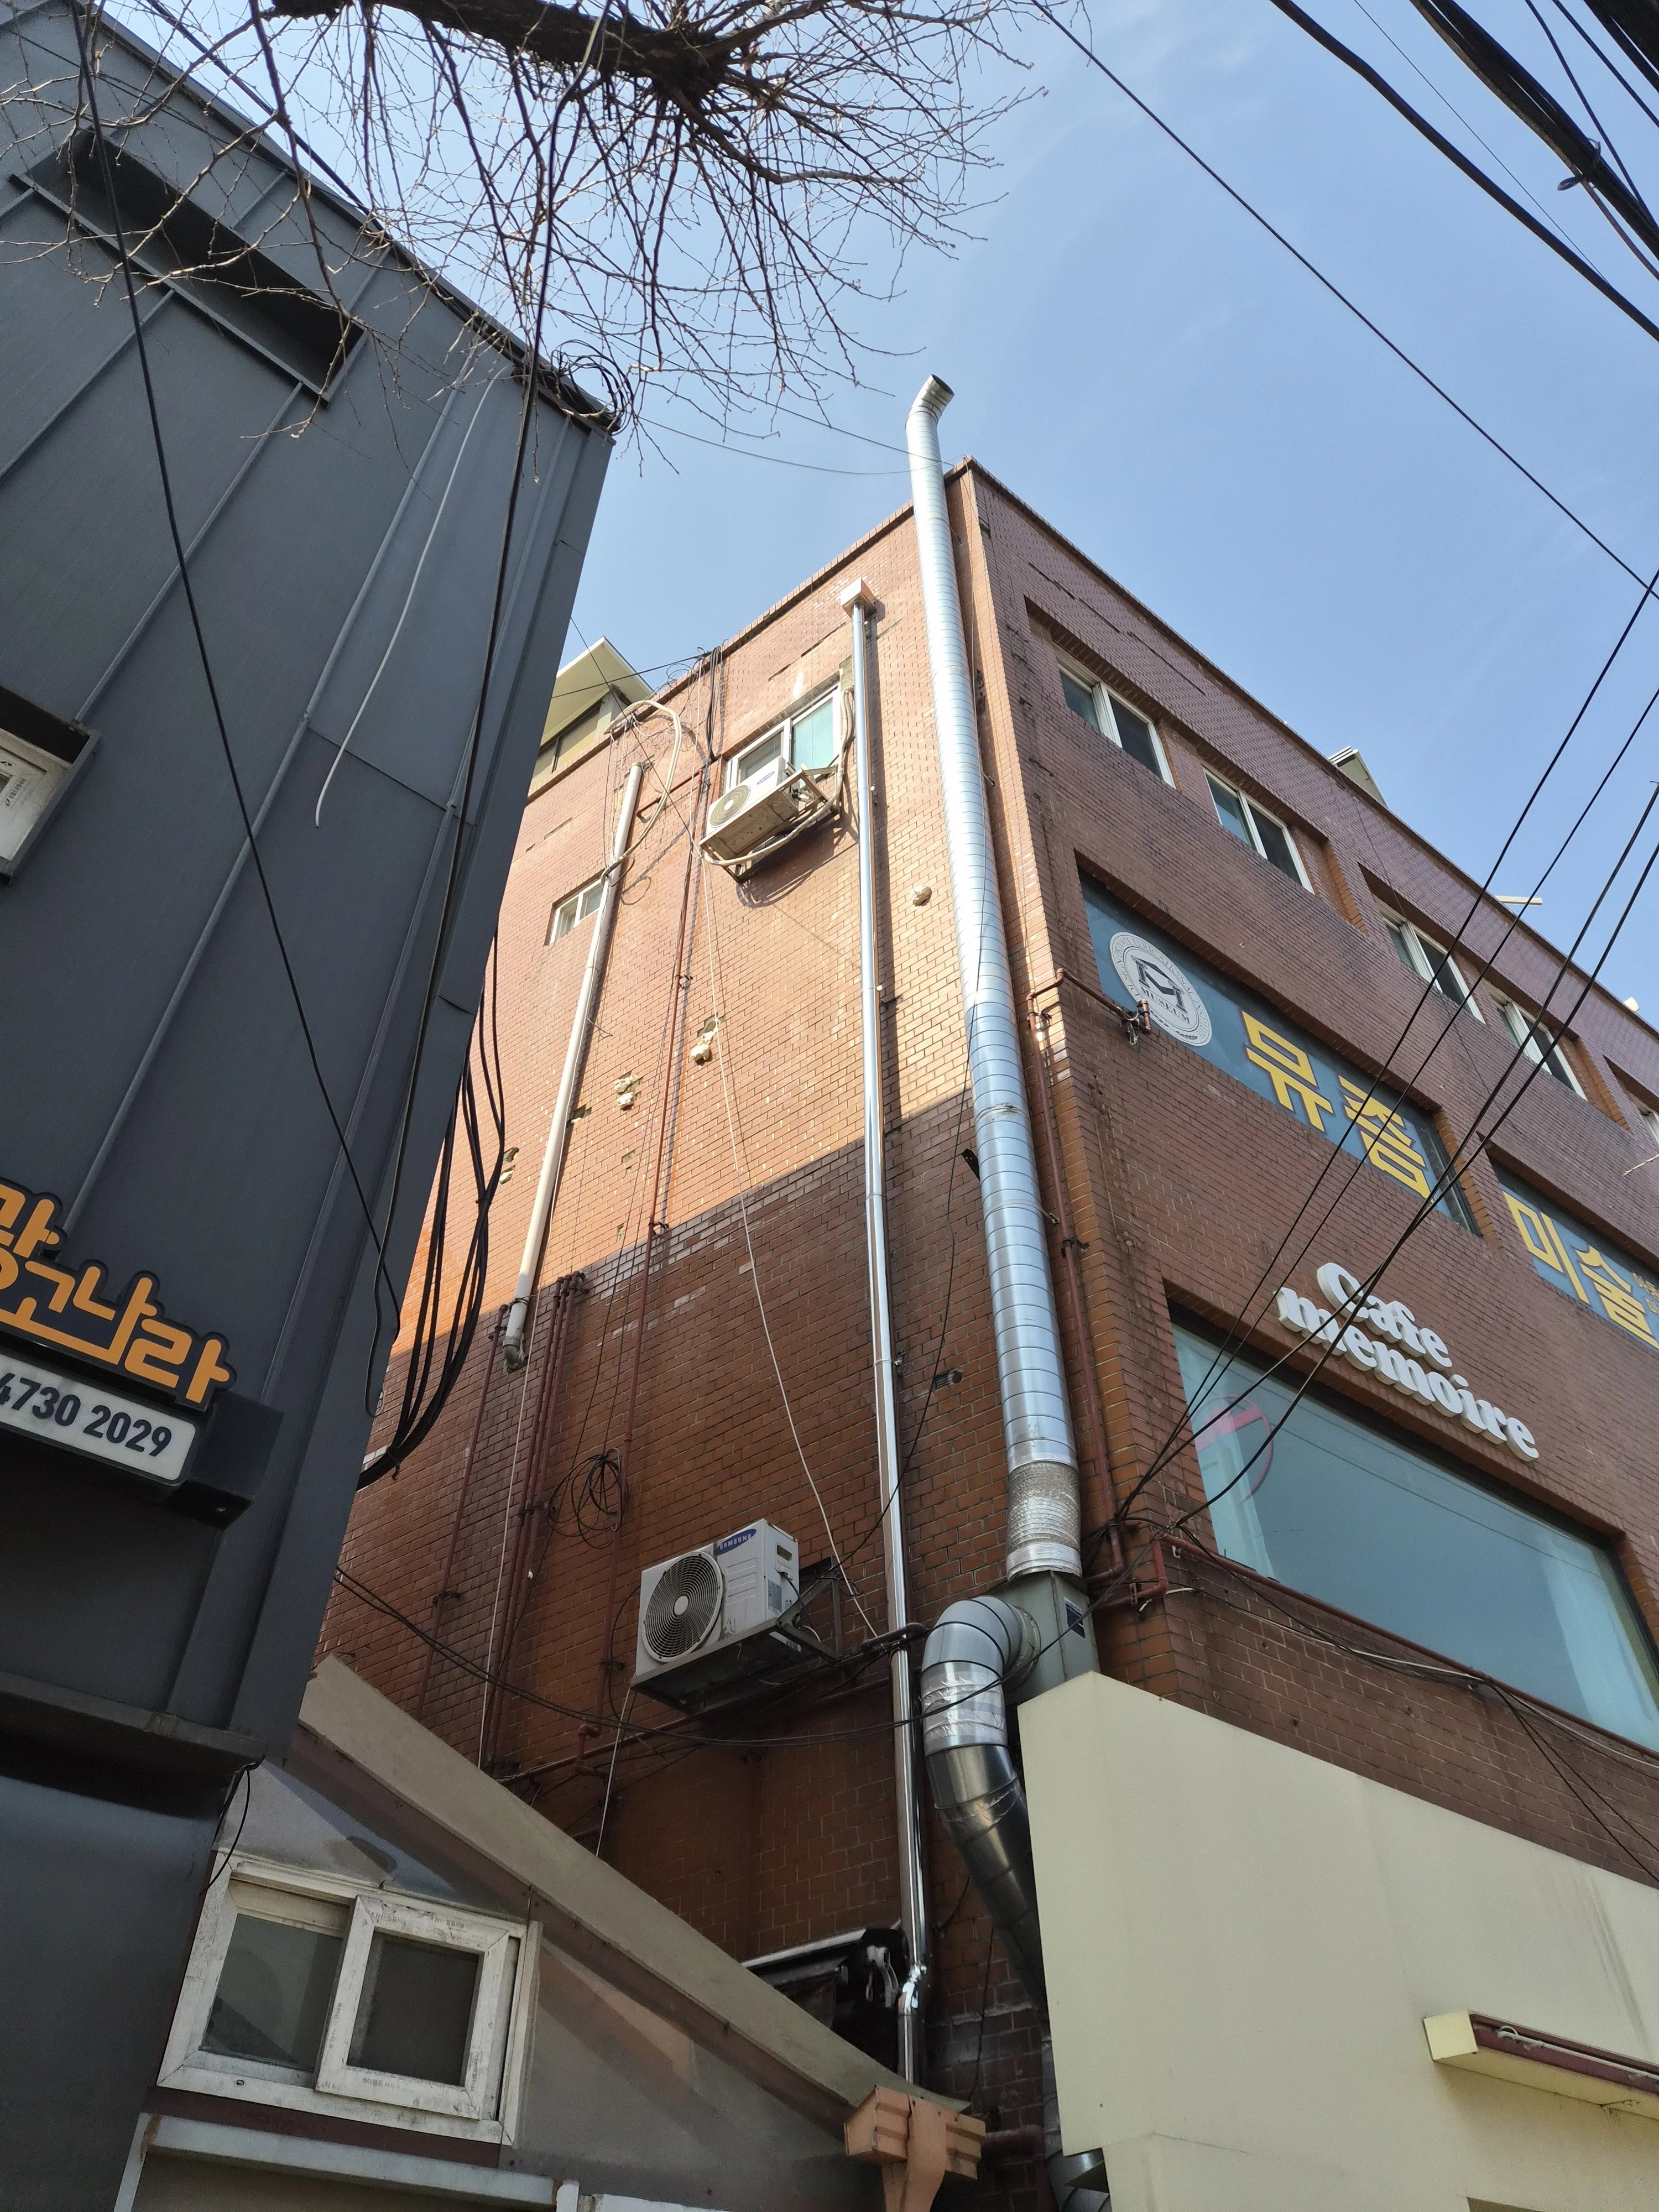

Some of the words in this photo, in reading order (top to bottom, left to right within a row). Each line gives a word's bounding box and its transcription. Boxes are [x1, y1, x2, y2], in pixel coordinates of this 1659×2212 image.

[1141, 986, 1190, 1024] MUSEUM
[1242, 1011, 1434, 1203] 뮤즘
[1317, 1262, 1452, 1371] Cafe
[1504, 1191, 1659, 1350] 미술
[1273, 1287, 1539, 1462] memoire
[83, 1405, 172, 1457] 2029
[719, 1533, 752, 1550] SAMSUNG
